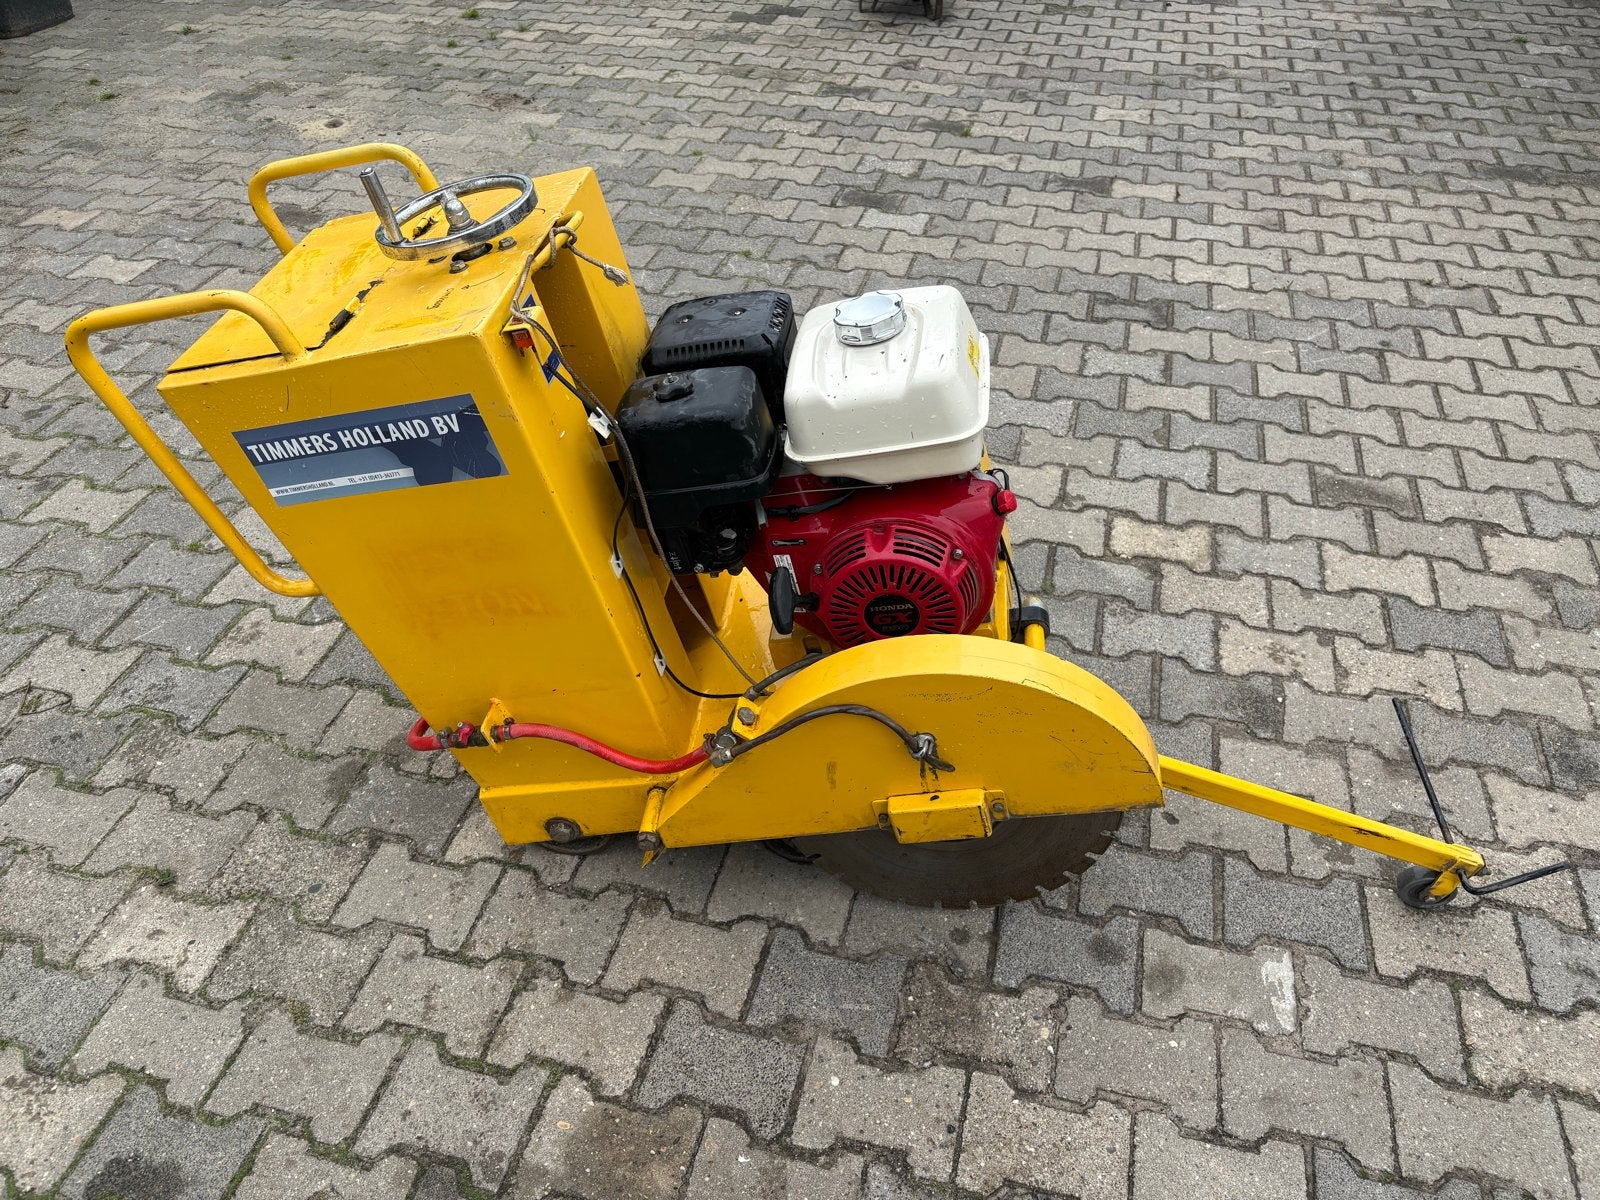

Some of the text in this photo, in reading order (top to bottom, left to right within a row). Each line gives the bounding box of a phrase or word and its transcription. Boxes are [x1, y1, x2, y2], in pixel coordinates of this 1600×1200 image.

[247, 413, 460, 463] TIMMERS HOLLAND BV
[870, 603, 914, 612] HONDA
[873, 611, 913, 624] GX
